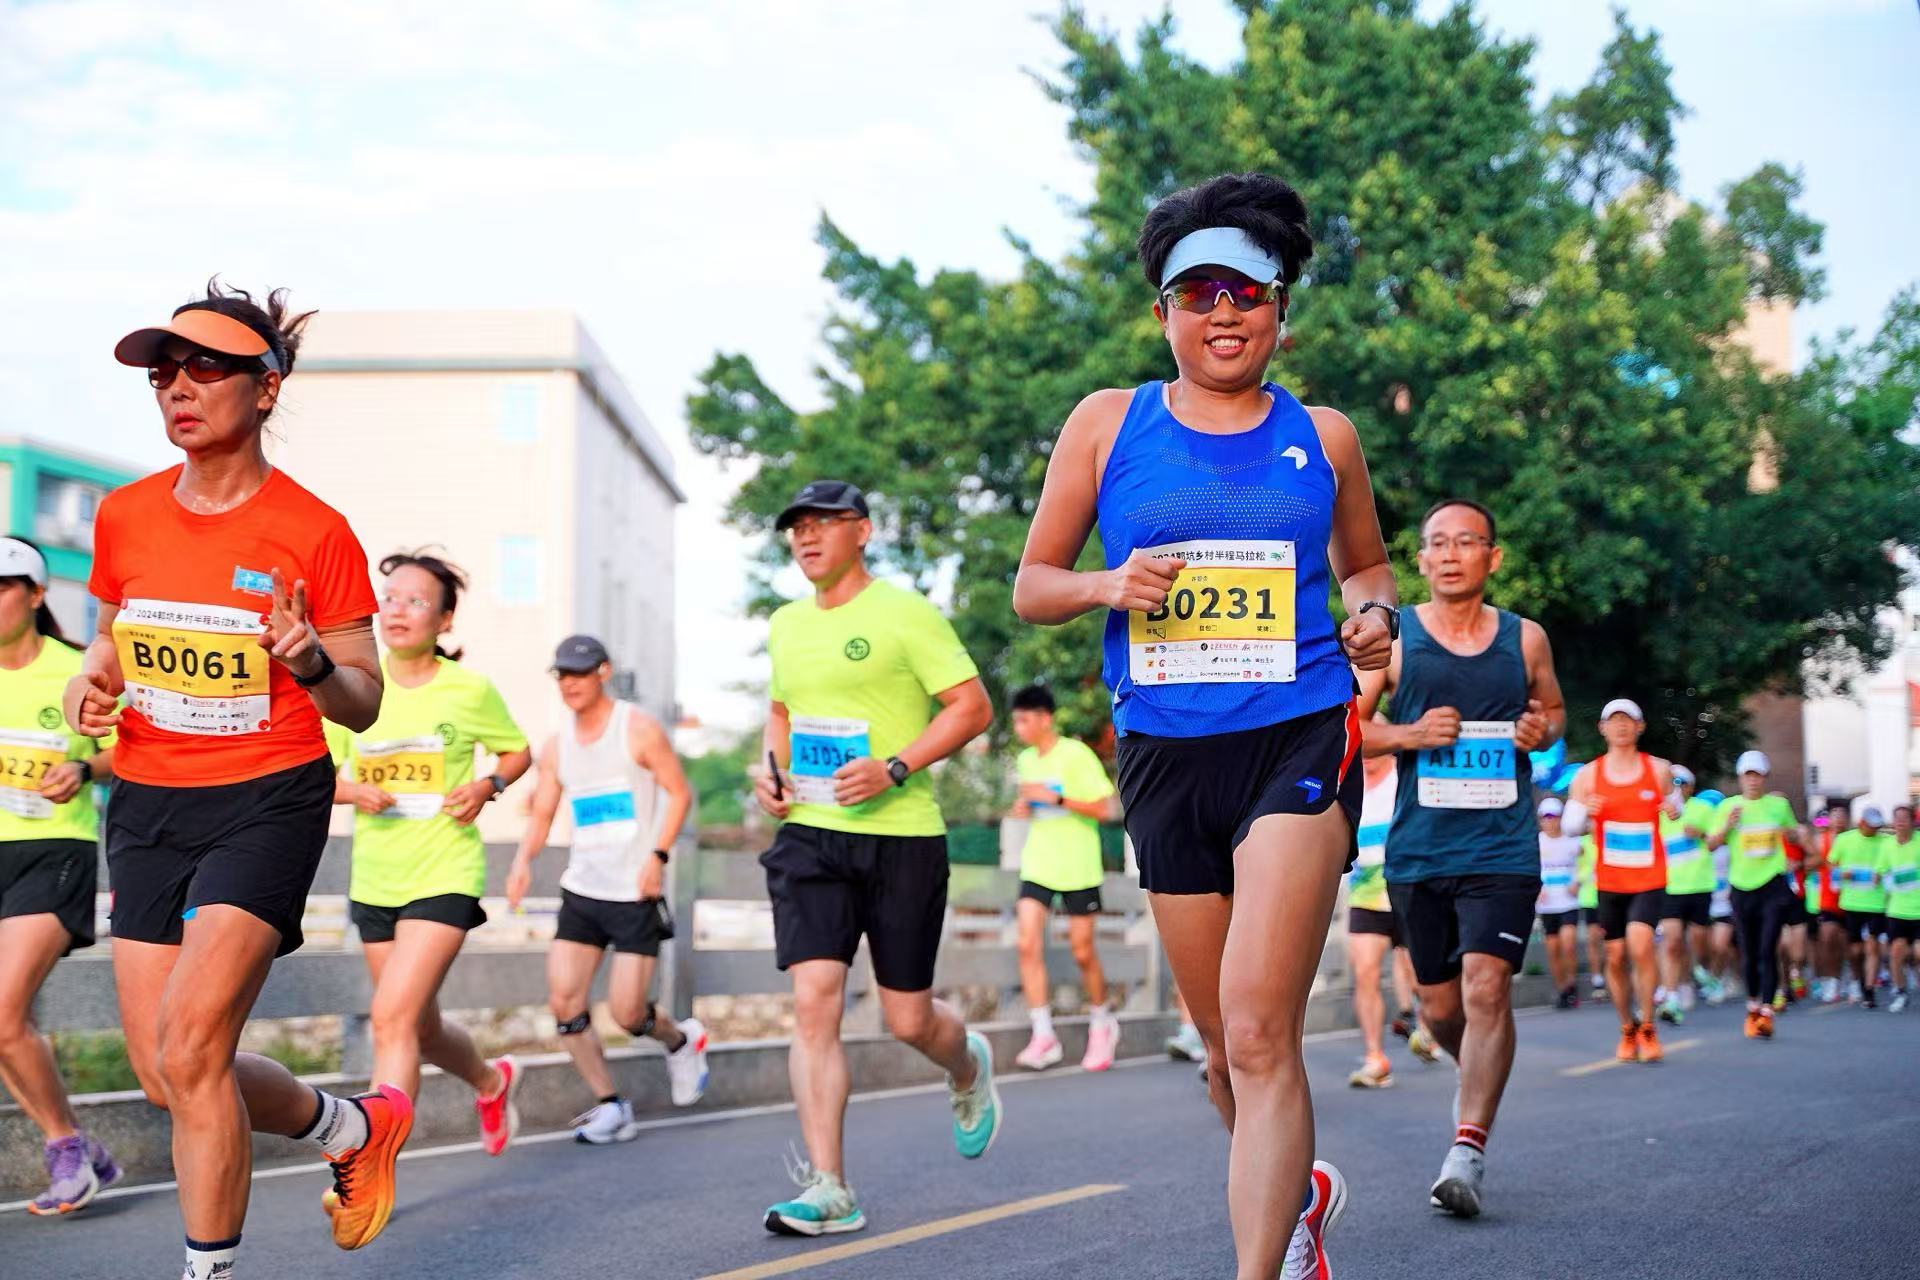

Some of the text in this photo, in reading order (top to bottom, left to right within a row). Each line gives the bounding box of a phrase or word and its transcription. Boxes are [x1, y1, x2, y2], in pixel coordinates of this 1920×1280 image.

[133, 641, 250, 679] B0061
[801, 745, 857, 767] A1036
[1430, 749, 1505, 768] A1107
[0, 757, 52, 780] 227
